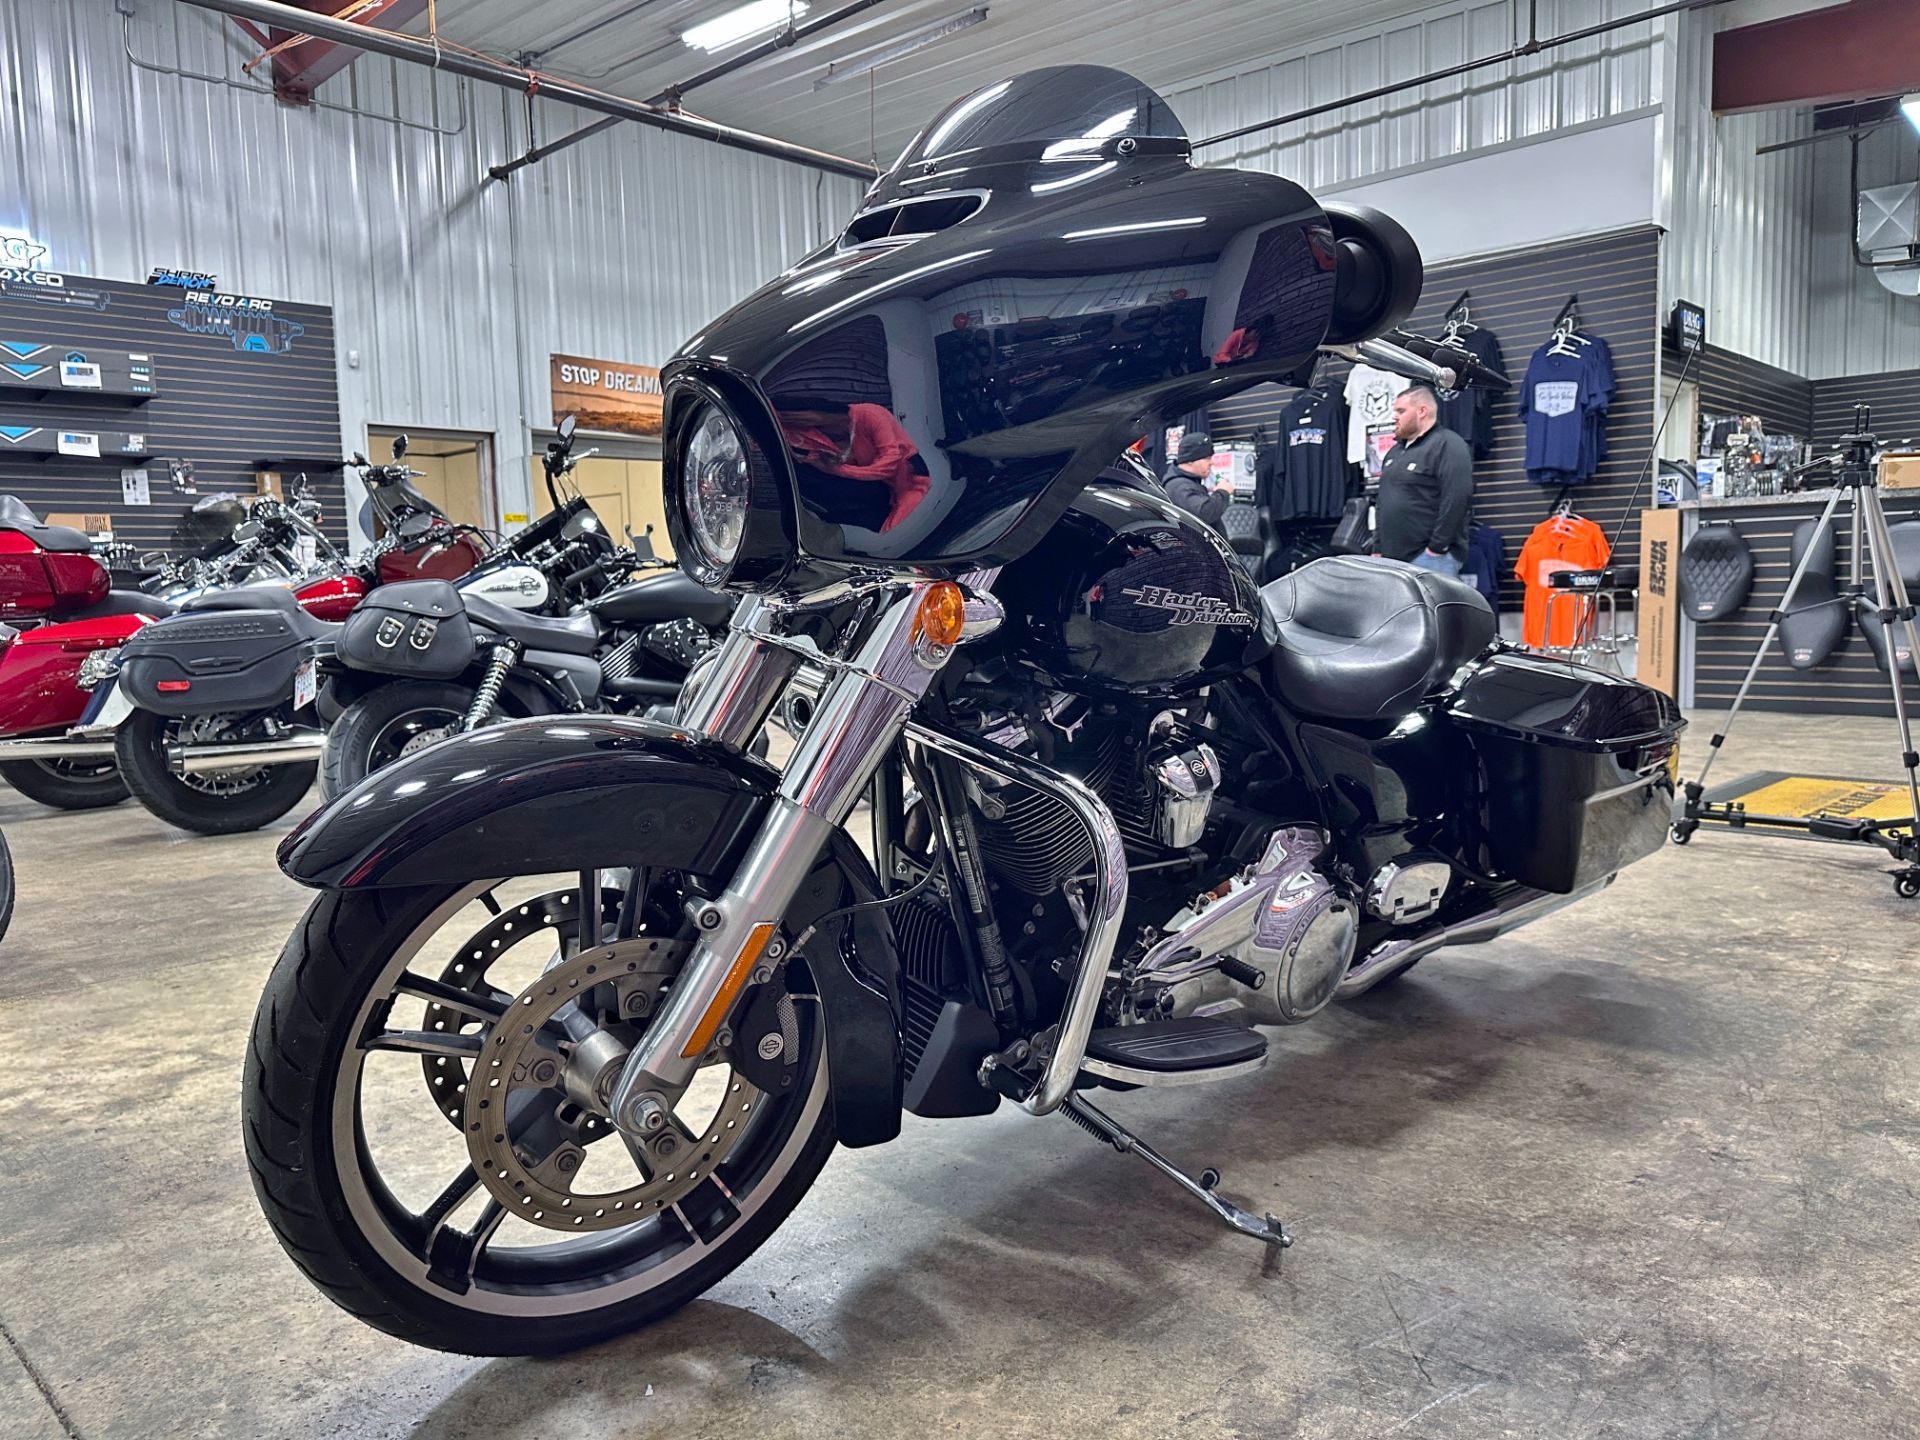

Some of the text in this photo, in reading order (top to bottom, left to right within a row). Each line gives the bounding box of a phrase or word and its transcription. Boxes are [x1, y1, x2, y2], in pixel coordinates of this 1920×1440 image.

[185, 291, 273, 311] REVO ARC
[560, 363, 600, 386] STOP
